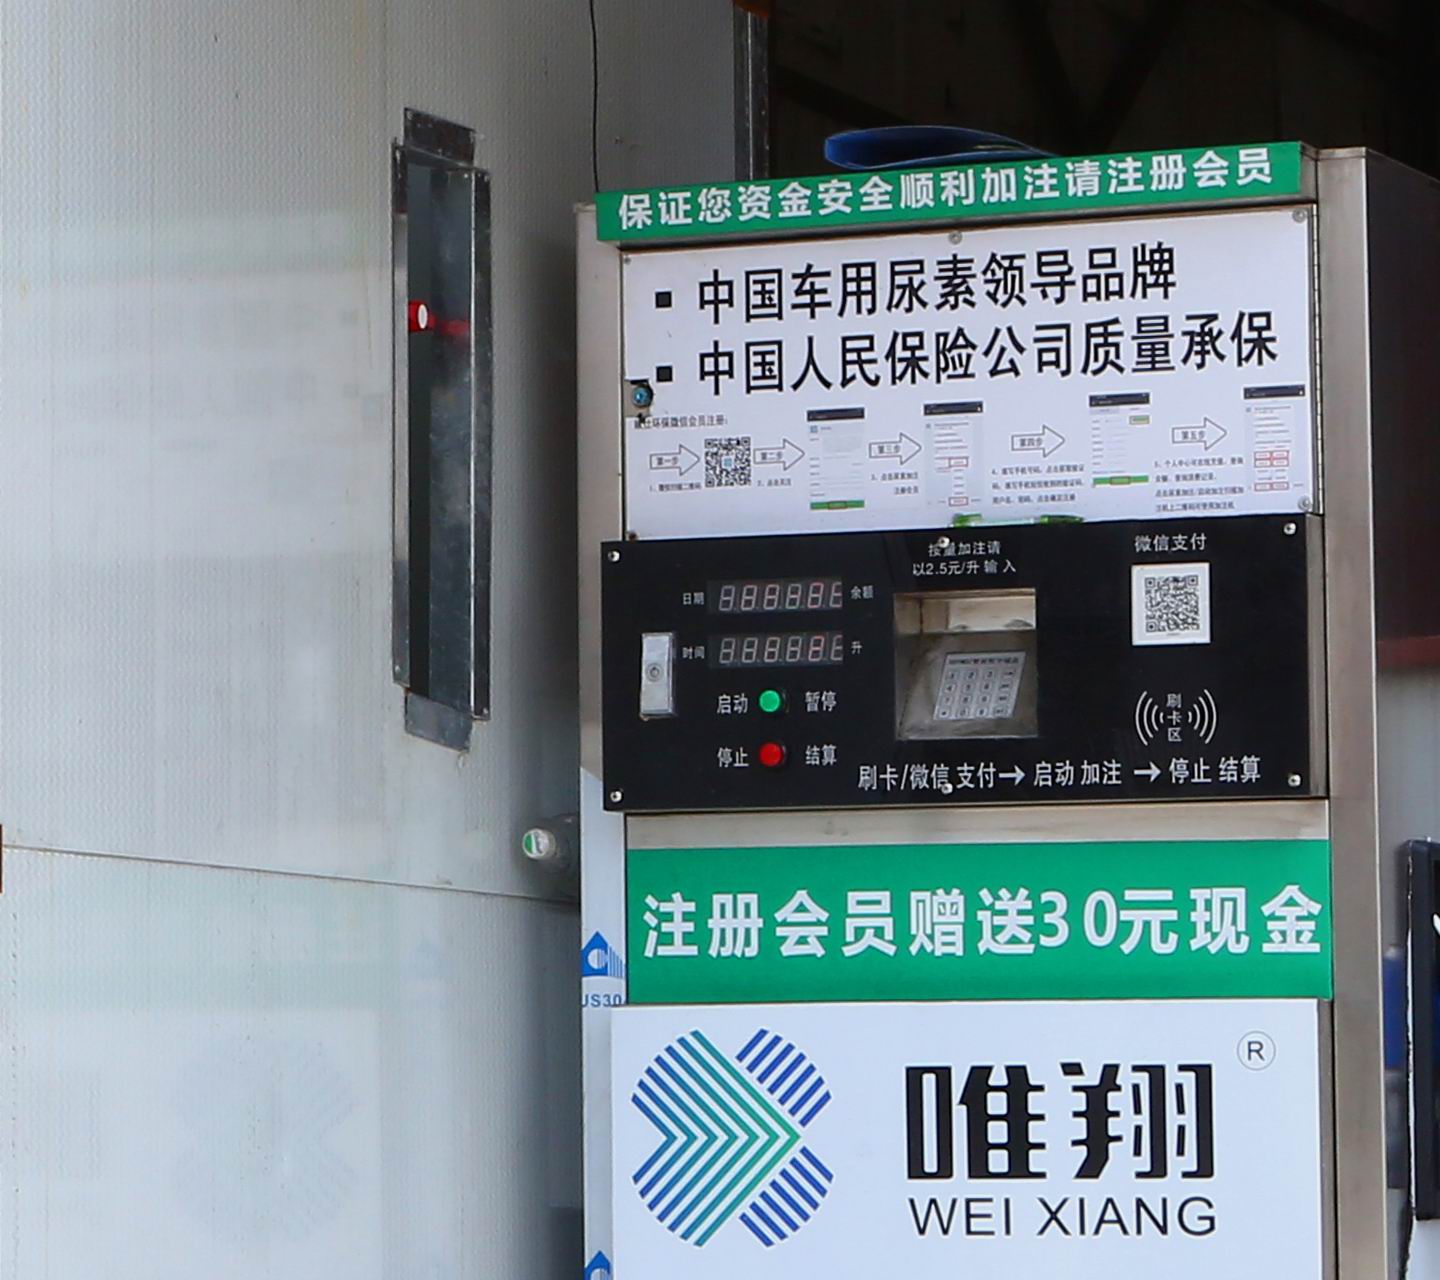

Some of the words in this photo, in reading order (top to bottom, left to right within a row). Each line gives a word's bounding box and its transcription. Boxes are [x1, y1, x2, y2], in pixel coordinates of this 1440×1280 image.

[618, 146, 1275, 230] 保证您资金安全顺利加注请注册会员
[697, 241, 1178, 324] 中国车用尿素领导品牌
[697, 309, 1280, 394] 中国人民保险公司质量承保
[1134, 532, 1207, 553] 微信支付
[682, 591, 705, 606] 日期
[850, 585, 874, 600] 余额
[682, 645, 705, 660] 时间
[851, 641, 863, 655] 升
[717, 693, 749, 715] 启动
[805, 691, 837, 712] 暂停
[717, 747, 749, 768] 停止
[805, 744, 837, 766] 结算
[643, 882, 1323, 960] 注册会员赠送30元现金
[904, 1061, 1214, 1180] 唯翔
[908, 1196, 1016, 1238] WEI
[1037, 1194, 1217, 1238] XIANG
